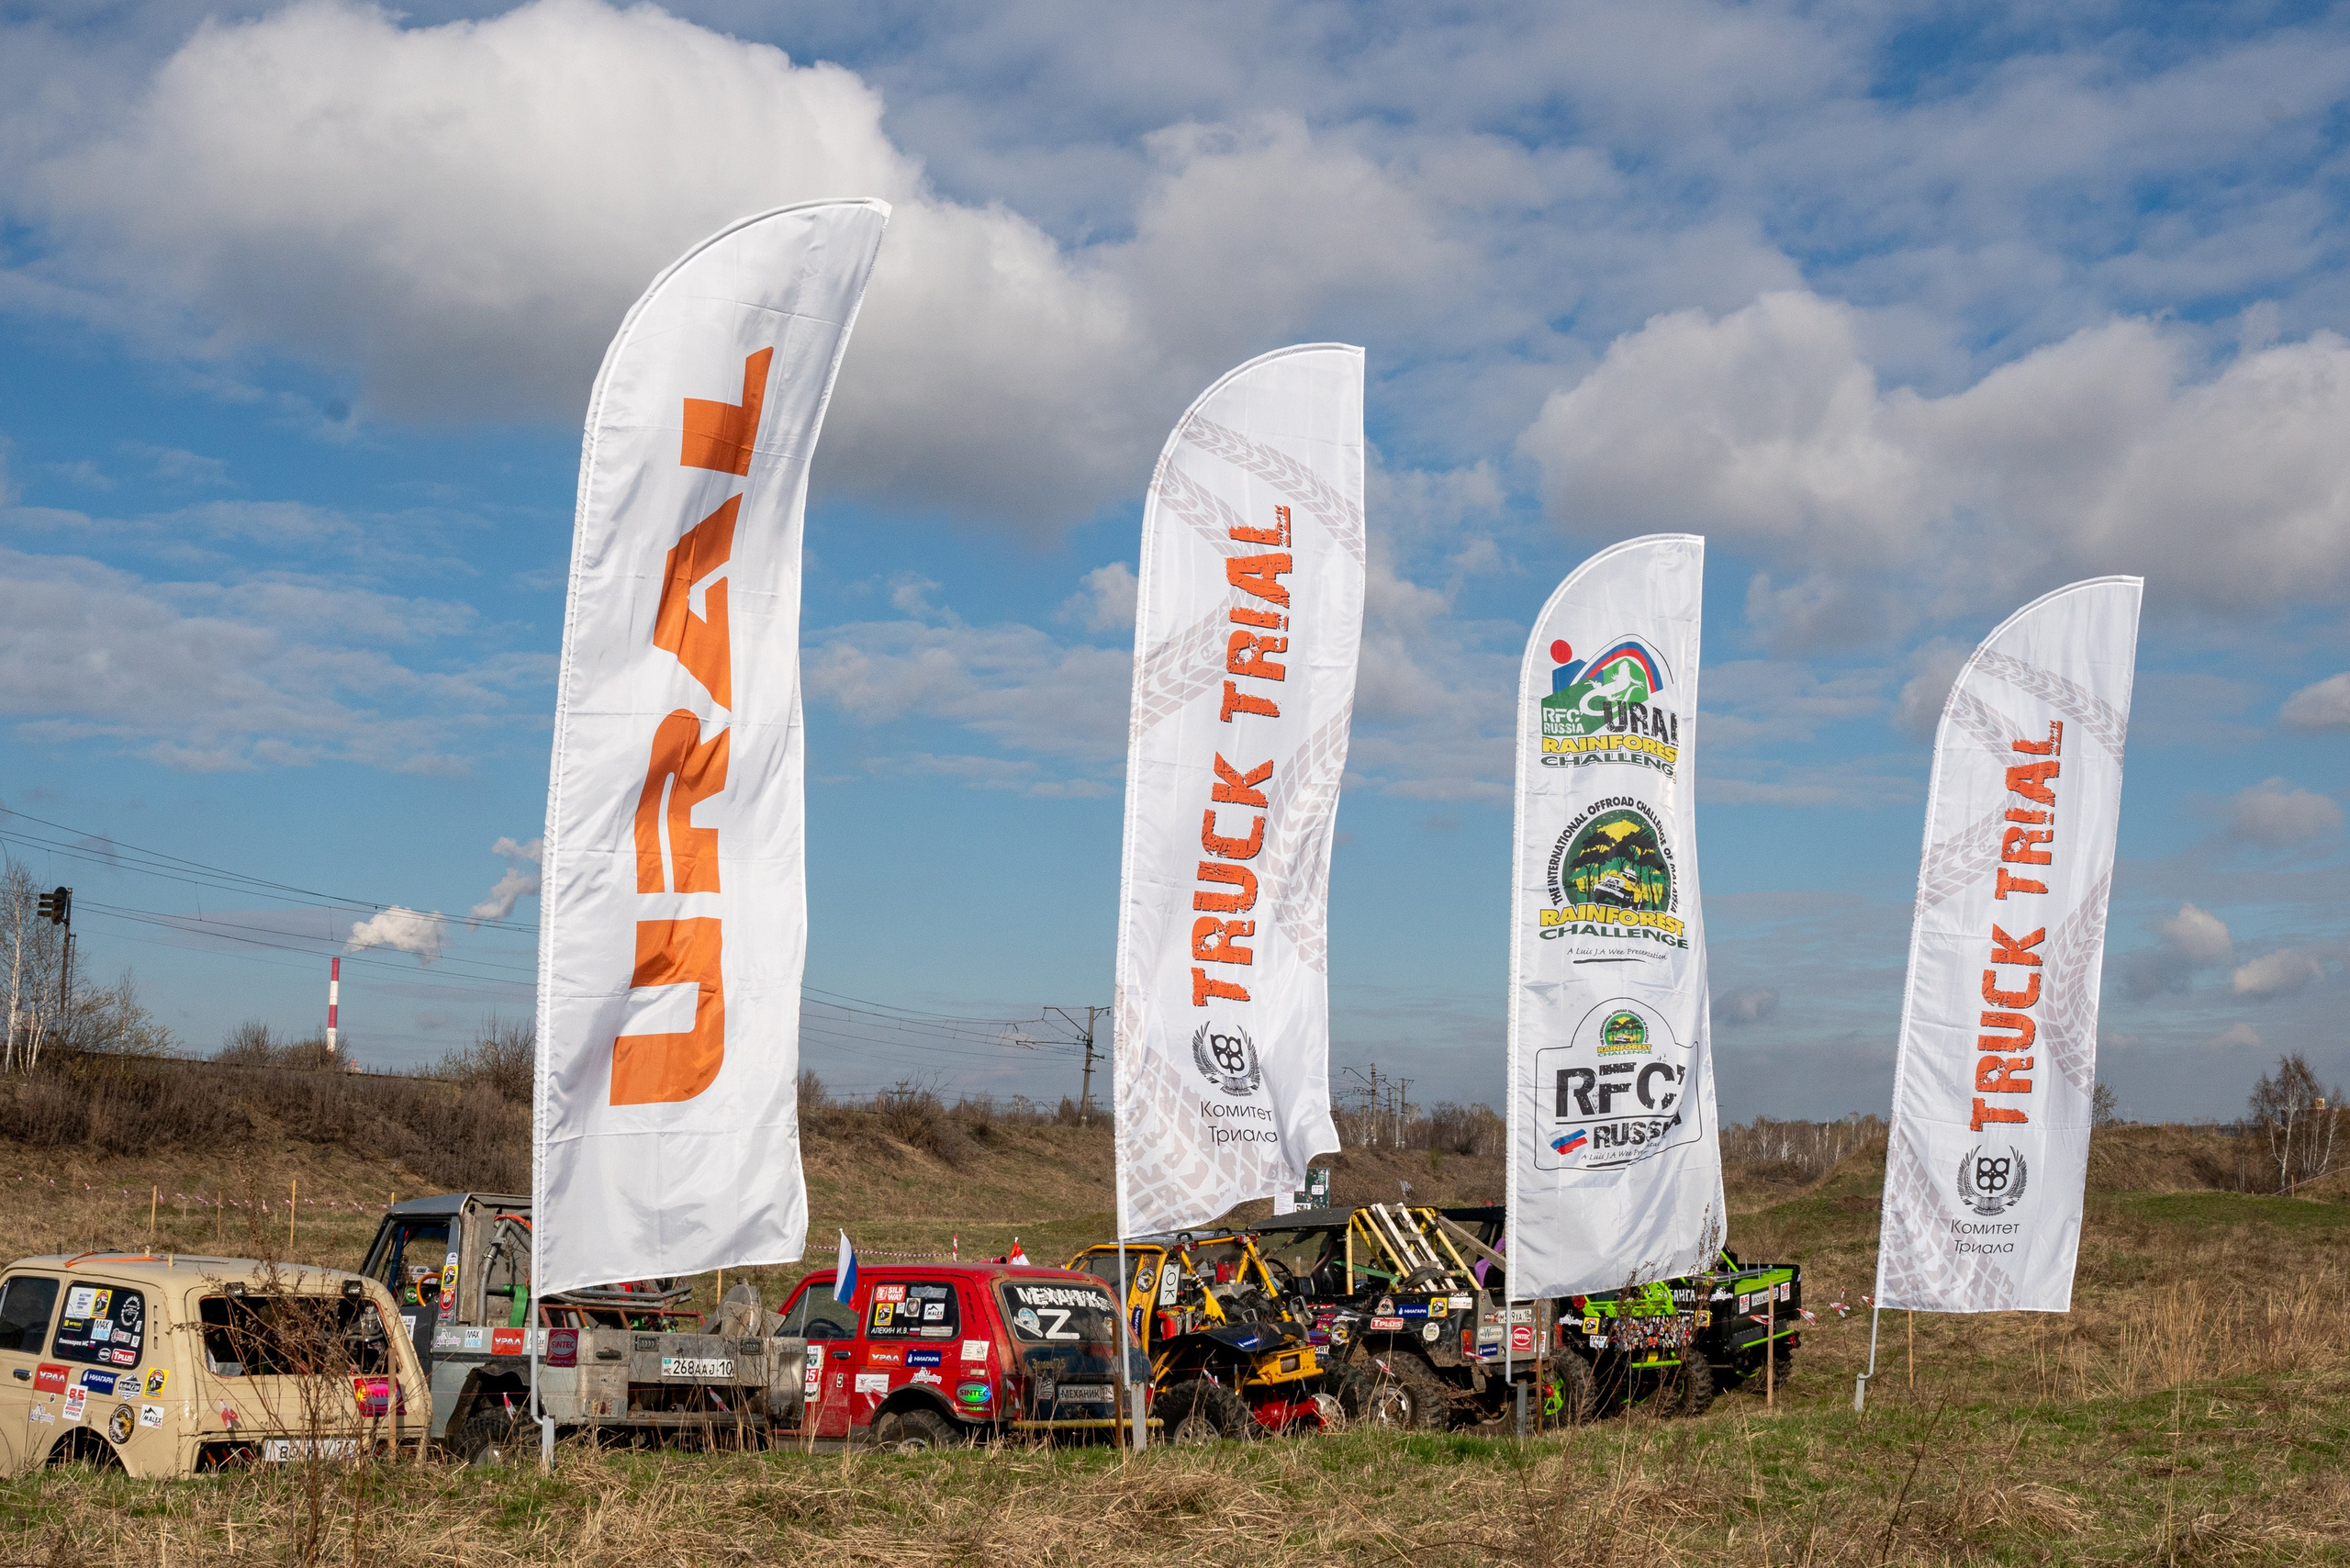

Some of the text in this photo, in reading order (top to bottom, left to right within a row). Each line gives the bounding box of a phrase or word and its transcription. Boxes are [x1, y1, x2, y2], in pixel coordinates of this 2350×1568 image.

[1220, 504, 1292, 722] TRIAL
[1543, 707, 1581, 722] RFC
[610, 346, 773, 1106] URAL
[1544, 722, 1584, 734] RUSSIA
[1540, 753, 1676, 783] CHALLENG
[1587, 796, 1634, 815] OFFROAD
[1994, 720, 2064, 901] TRIAL
[1636, 801, 1666, 846] CHALLENGE
[1548, 812, 1588, 886] INTERNATIONAL
[1663, 847, 1673, 861] OF
[1192, 751, 1273, 1006] TRUCK
[1550, 888, 1563, 906] THE
[1539, 903, 1685, 936] RAINFOREST
[1539, 924, 1689, 949] CHALLENGE
[1576, 947, 1593, 956] Luis
[1970, 923, 2045, 1132] TRUCK
[1597, 1043, 1652, 1053] RAINFOREST
[1201, 1101, 1272, 1121] Комитет
[1208, 1126, 1278, 1147] Триала
[1951, 1218, 2020, 1234] Комитет
[1954, 1239, 2014, 1254] Триала
[1013, 1285, 1099, 1307] МЕХАНИК
[1036, 1308, 1080, 1339] Z
[1500, 1311, 1523, 1322] М9ХА
[95, 1320, 110, 1330] MAX
[466, 1330, 479, 1338] MAX
[495, 1337, 521, 1345] УРАЛ
[551, 1340, 574, 1349] SINTEC
[872, 1353, 900, 1361] УРАЛ
[719, 1361, 732, 1375] 10
[39, 1371, 65, 1383] УРАЛ
[89, 1373, 114, 1383] НИАГАРА
[836, 1374, 844, 1386] 5
[69, 1387, 85, 1401] 85
[959, 1388, 989, 1397] SINTEC
[1061, 1389, 1100, 1399] МЕХАНИК
[143, 1415, 162, 1424] MALEX
